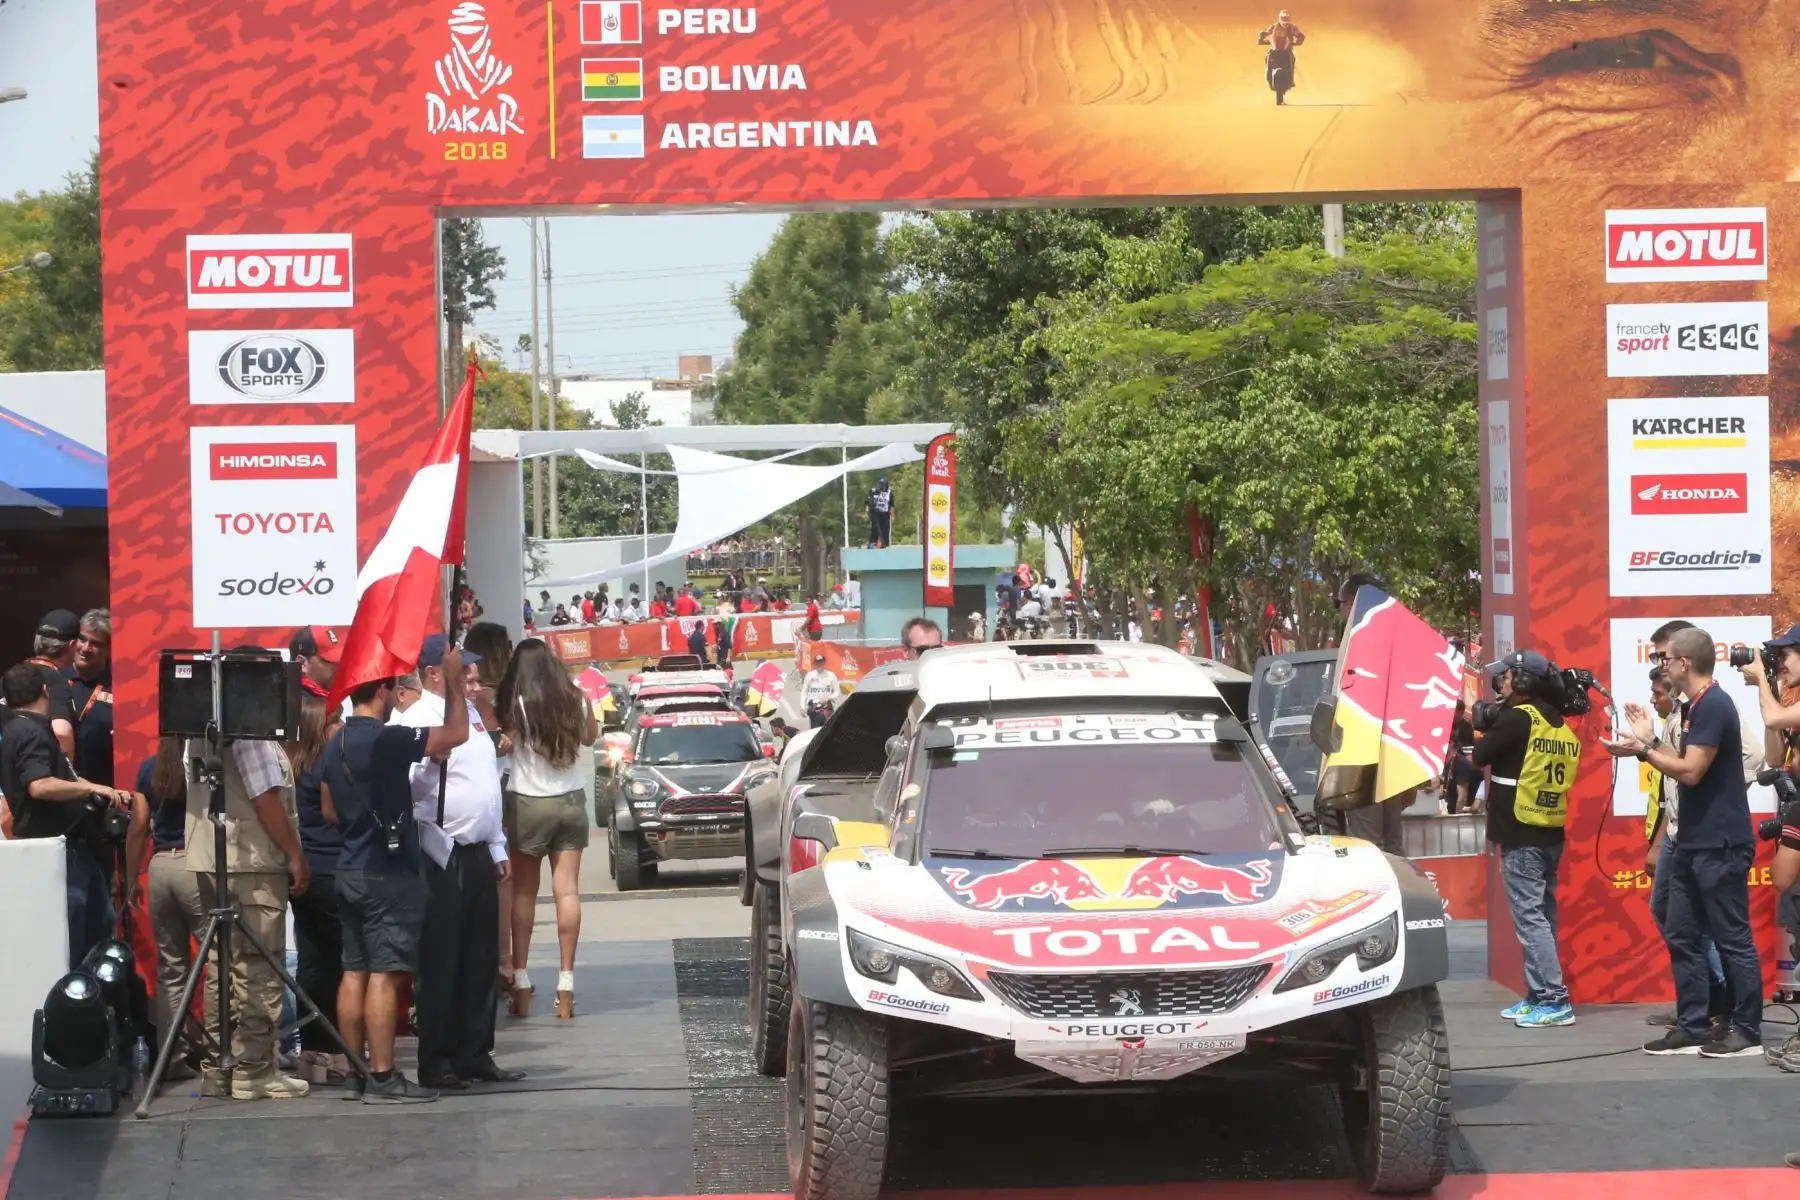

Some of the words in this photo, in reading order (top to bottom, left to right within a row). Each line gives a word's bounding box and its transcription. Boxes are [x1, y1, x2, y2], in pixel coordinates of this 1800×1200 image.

[658, 8, 757, 34] PERU
[659, 64, 807, 91] BOLIVIA
[425, 92, 524, 135] DAKAR
[660, 120, 878, 149] ARGENTINA
[444, 142, 507, 160] 2018
[1615, 228, 1758, 262] MOTUL
[197, 254, 343, 288] MOTUL
[1616, 322, 1672, 335] francetv
[1617, 334, 1670, 354] sport
[241, 347, 302, 374] FOX
[241, 374, 303, 387] SPORTS
[1632, 417, 1746, 435] KÄRCHER
[220, 453, 327, 468] HIMOINSA
[1660, 488, 1740, 500] HONDA
[215, 512, 335, 535] TOYOTA
[1629, 550, 1752, 566] BFGoodrich
[218, 571, 335, 596] sodexo
[956, 727, 1212, 746] PEUGEOT
[1566, 741, 1579, 757] TV
[1543, 761, 1566, 785] 16
[1281, 911, 1311, 926] 306
[993, 925, 1260, 957] TOTAL
[1313, 974, 1390, 1002] BFGoodrich
[867, 990, 950, 1013] BFGoodrich
[1067, 1023, 1192, 1036] PEUGEOT
